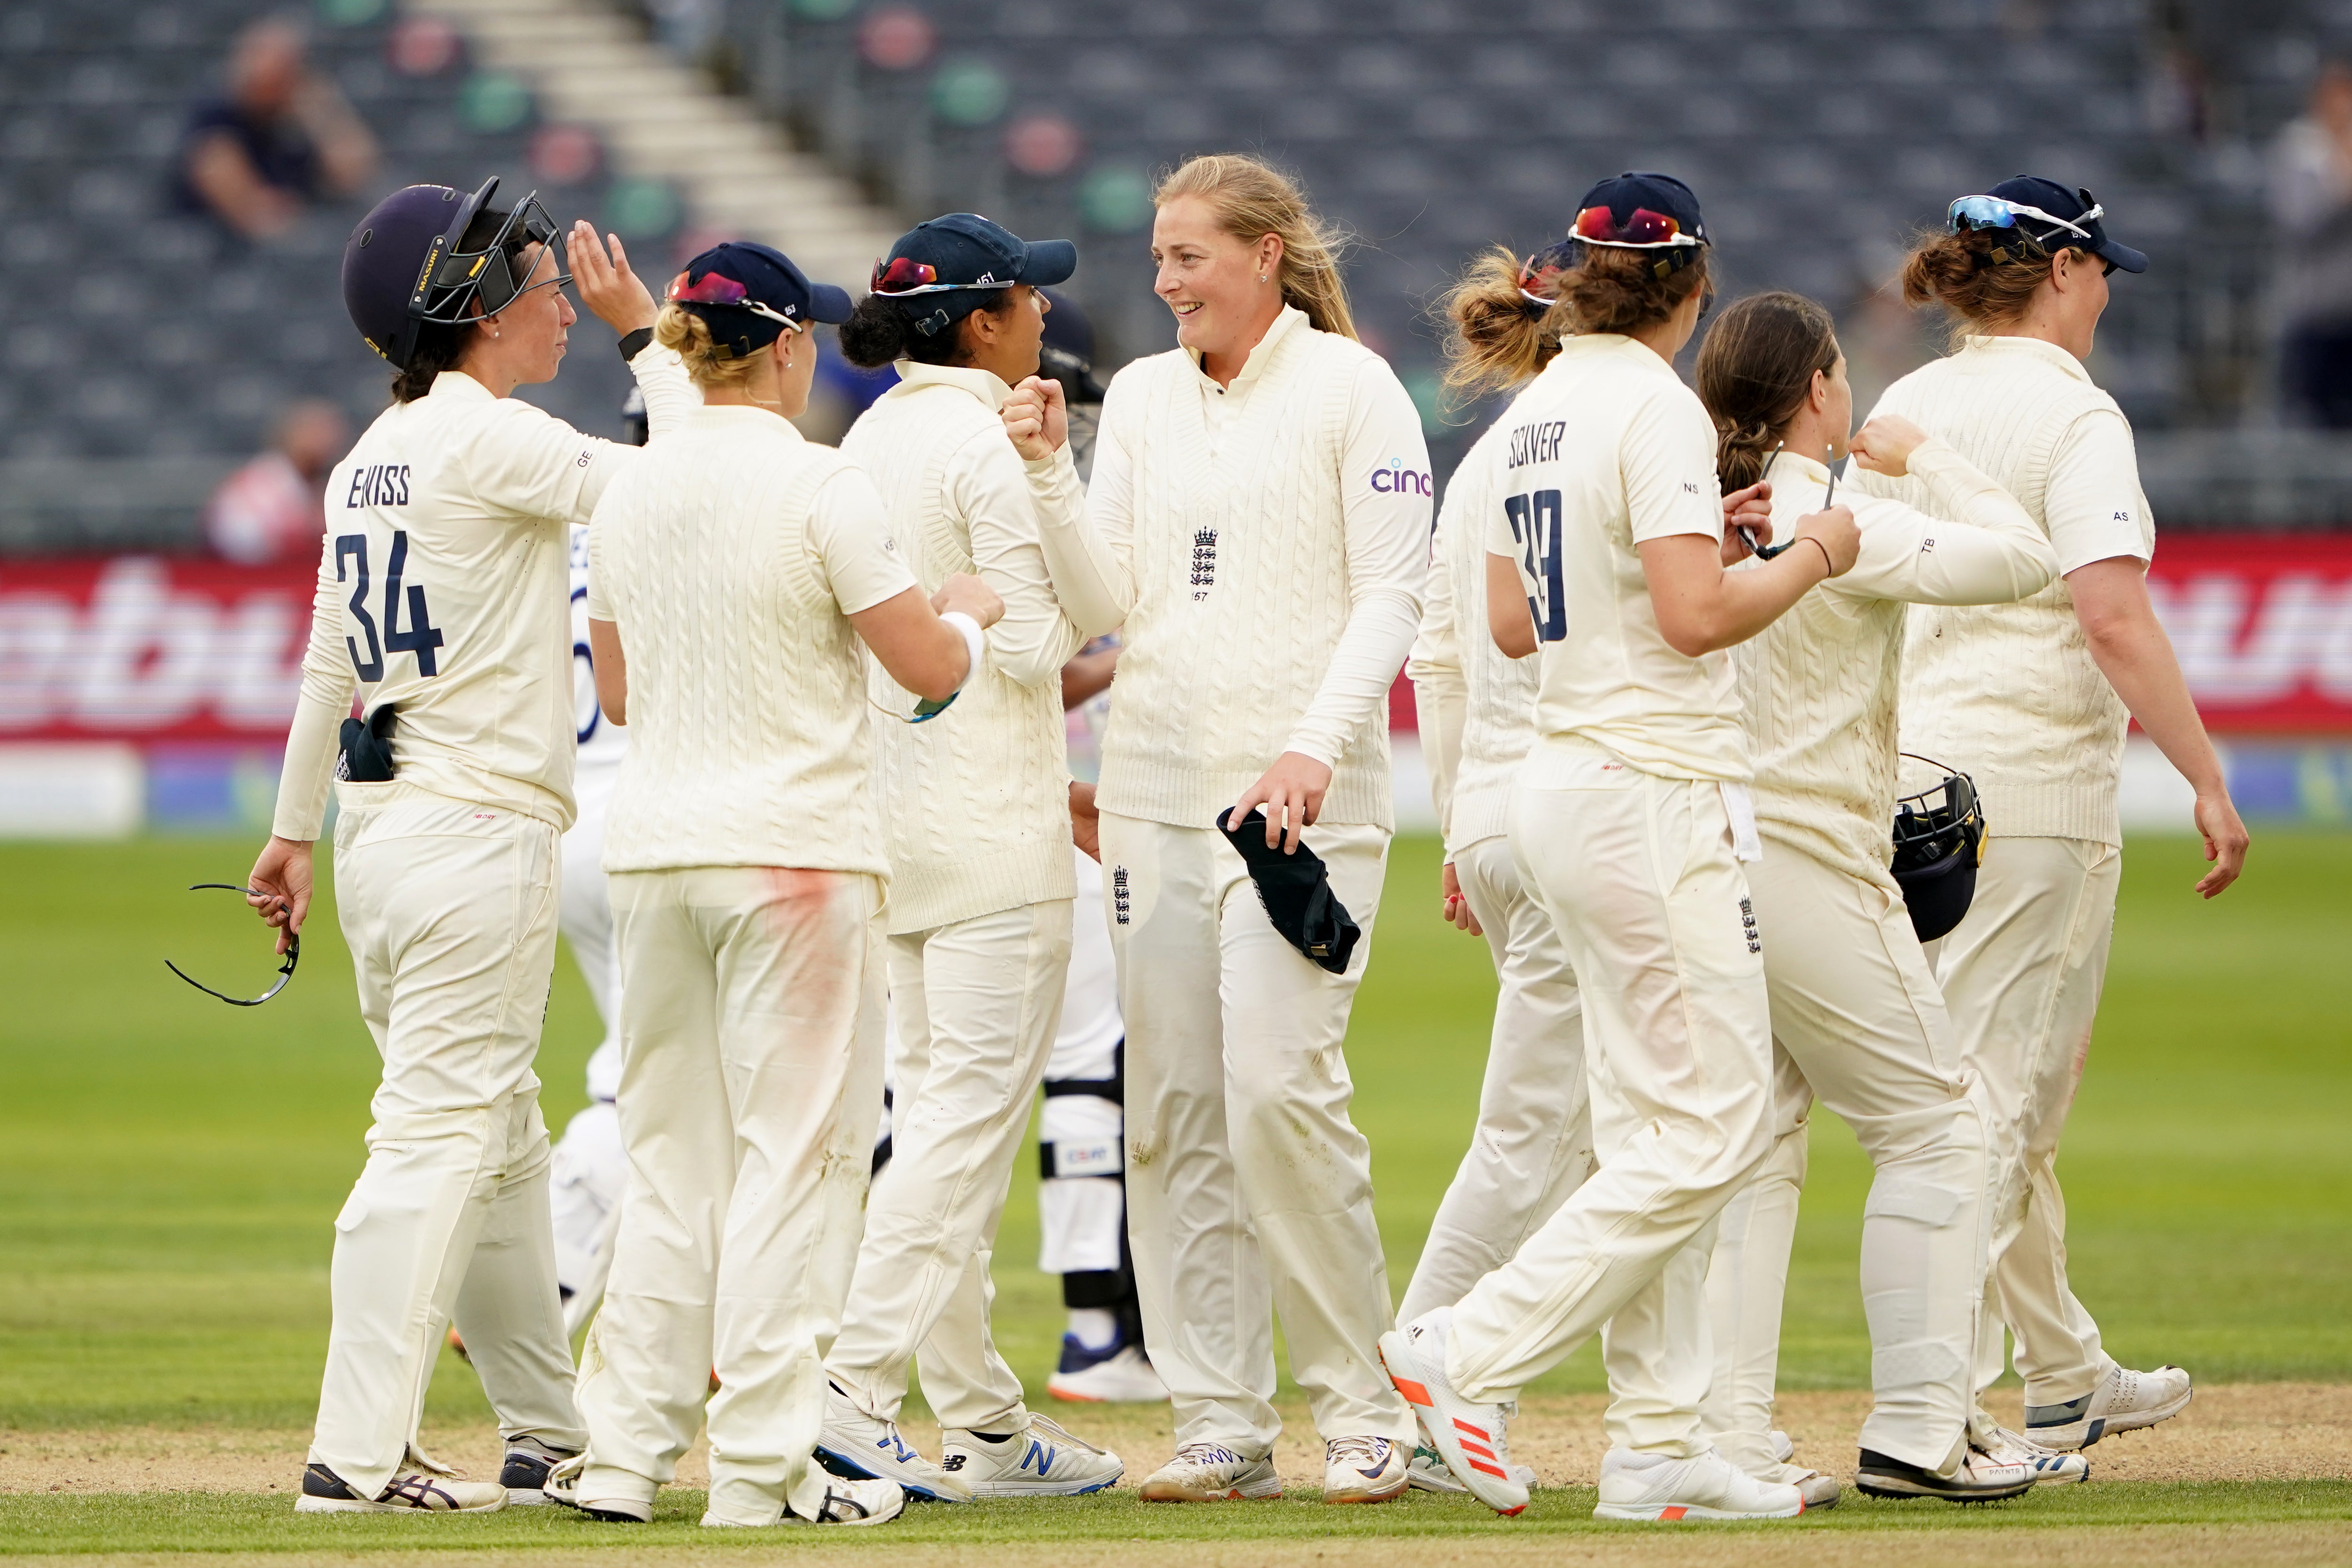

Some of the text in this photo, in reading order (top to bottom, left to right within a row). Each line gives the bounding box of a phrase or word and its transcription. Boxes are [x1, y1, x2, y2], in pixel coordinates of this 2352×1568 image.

[419, 249, 439, 292] MASURI
[577, 450, 593, 467] GE
[1509, 421, 1566, 469] SCIVER
[1371, 458, 1434, 500] cinc
[1684, 482, 1698, 494] NS
[2114, 512, 2128, 521] AS
[1505, 489, 1567, 644] 39
[1921, 539, 1935, 553] TB
[335, 530, 444, 683] 34
